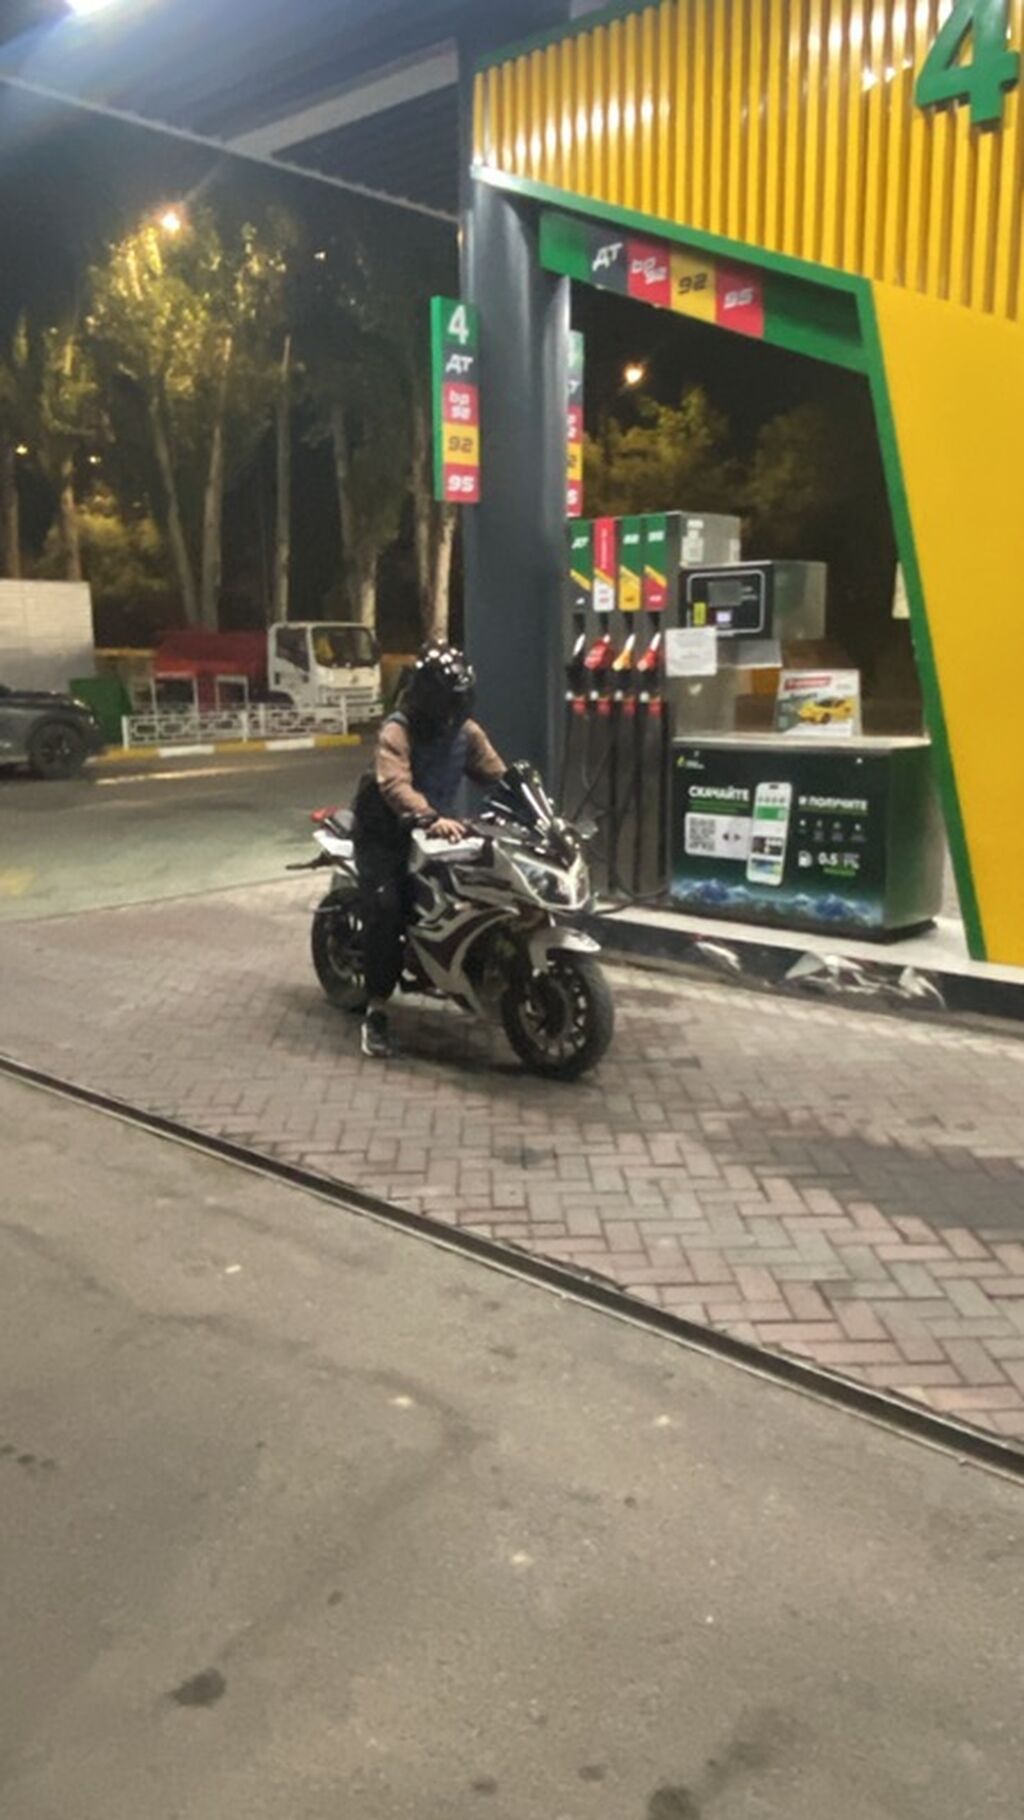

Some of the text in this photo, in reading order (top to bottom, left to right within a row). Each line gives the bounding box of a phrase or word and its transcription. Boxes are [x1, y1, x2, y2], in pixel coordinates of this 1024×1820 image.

[915, 0, 1020, 123] 4
[592, 243, 623, 271] ДТ
[678, 273, 708, 294] 92
[724, 287, 753, 309] 95
[448, 305, 469, 344] 4
[445, 354, 473, 374] ДТ
[447, 436, 473, 452] 92
[447, 475, 474, 492] 95
